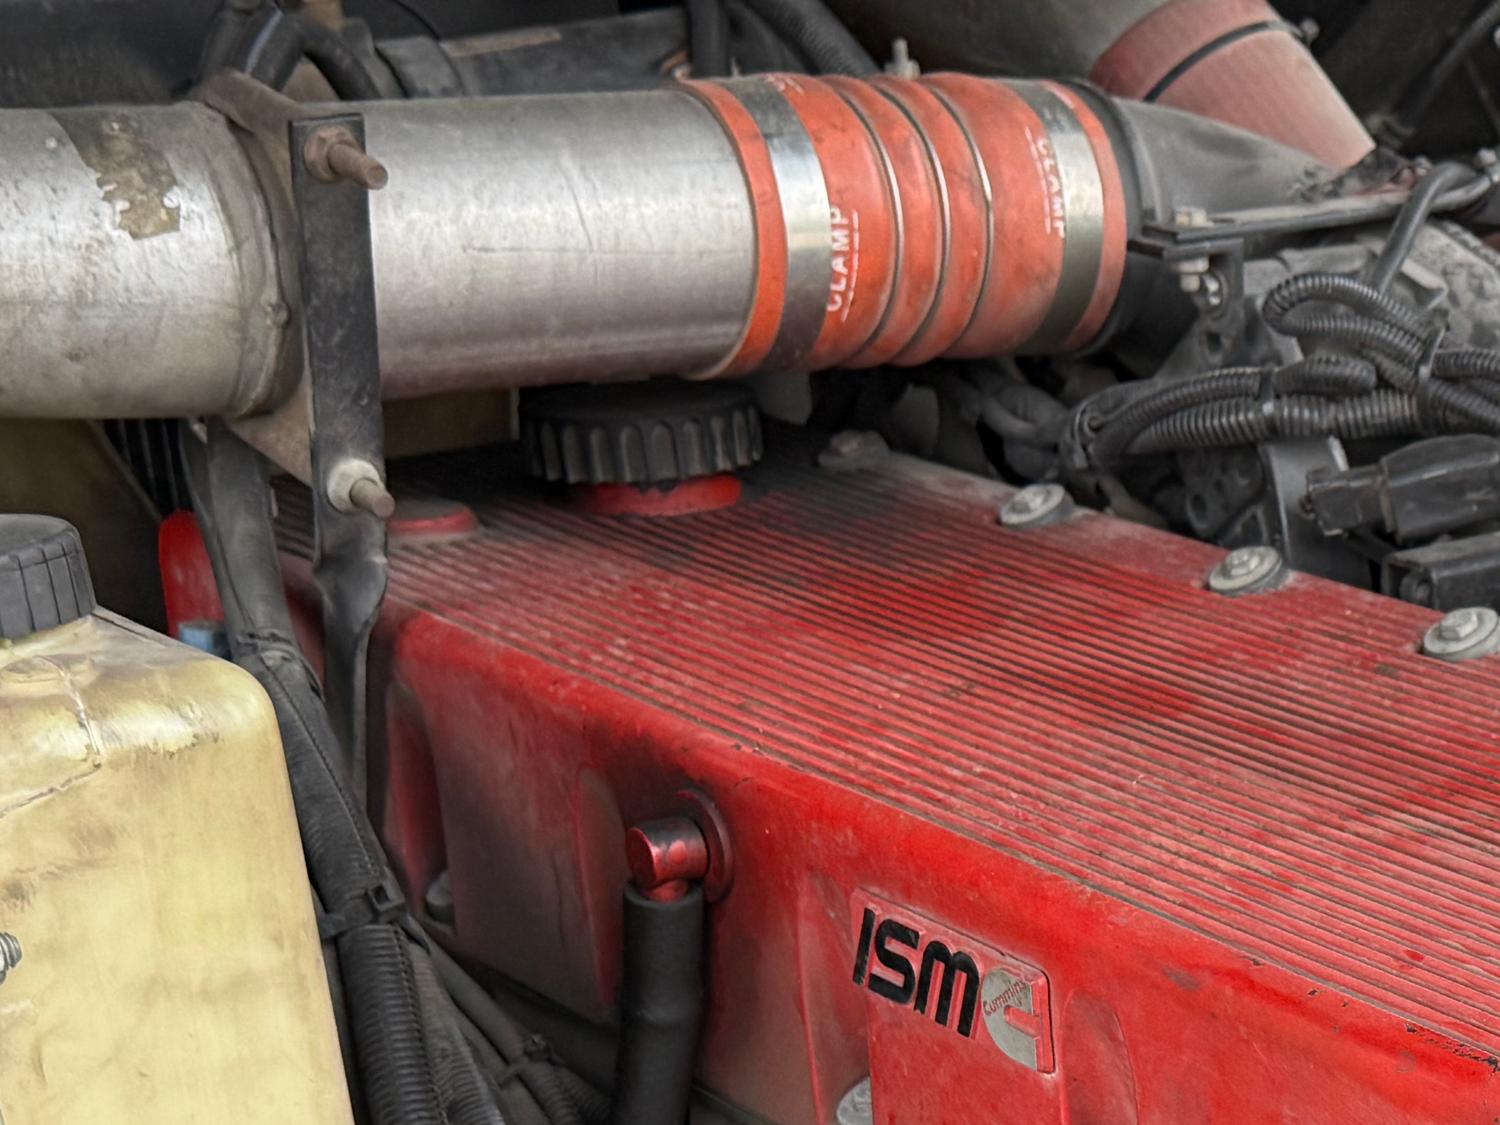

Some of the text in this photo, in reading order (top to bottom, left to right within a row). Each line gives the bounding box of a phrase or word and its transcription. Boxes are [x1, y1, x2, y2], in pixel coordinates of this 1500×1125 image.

[827, 205, 850, 312] CLAMP
[853, 907, 980, 1039] ISM
[982, 980, 1027, 1017] Cummins
